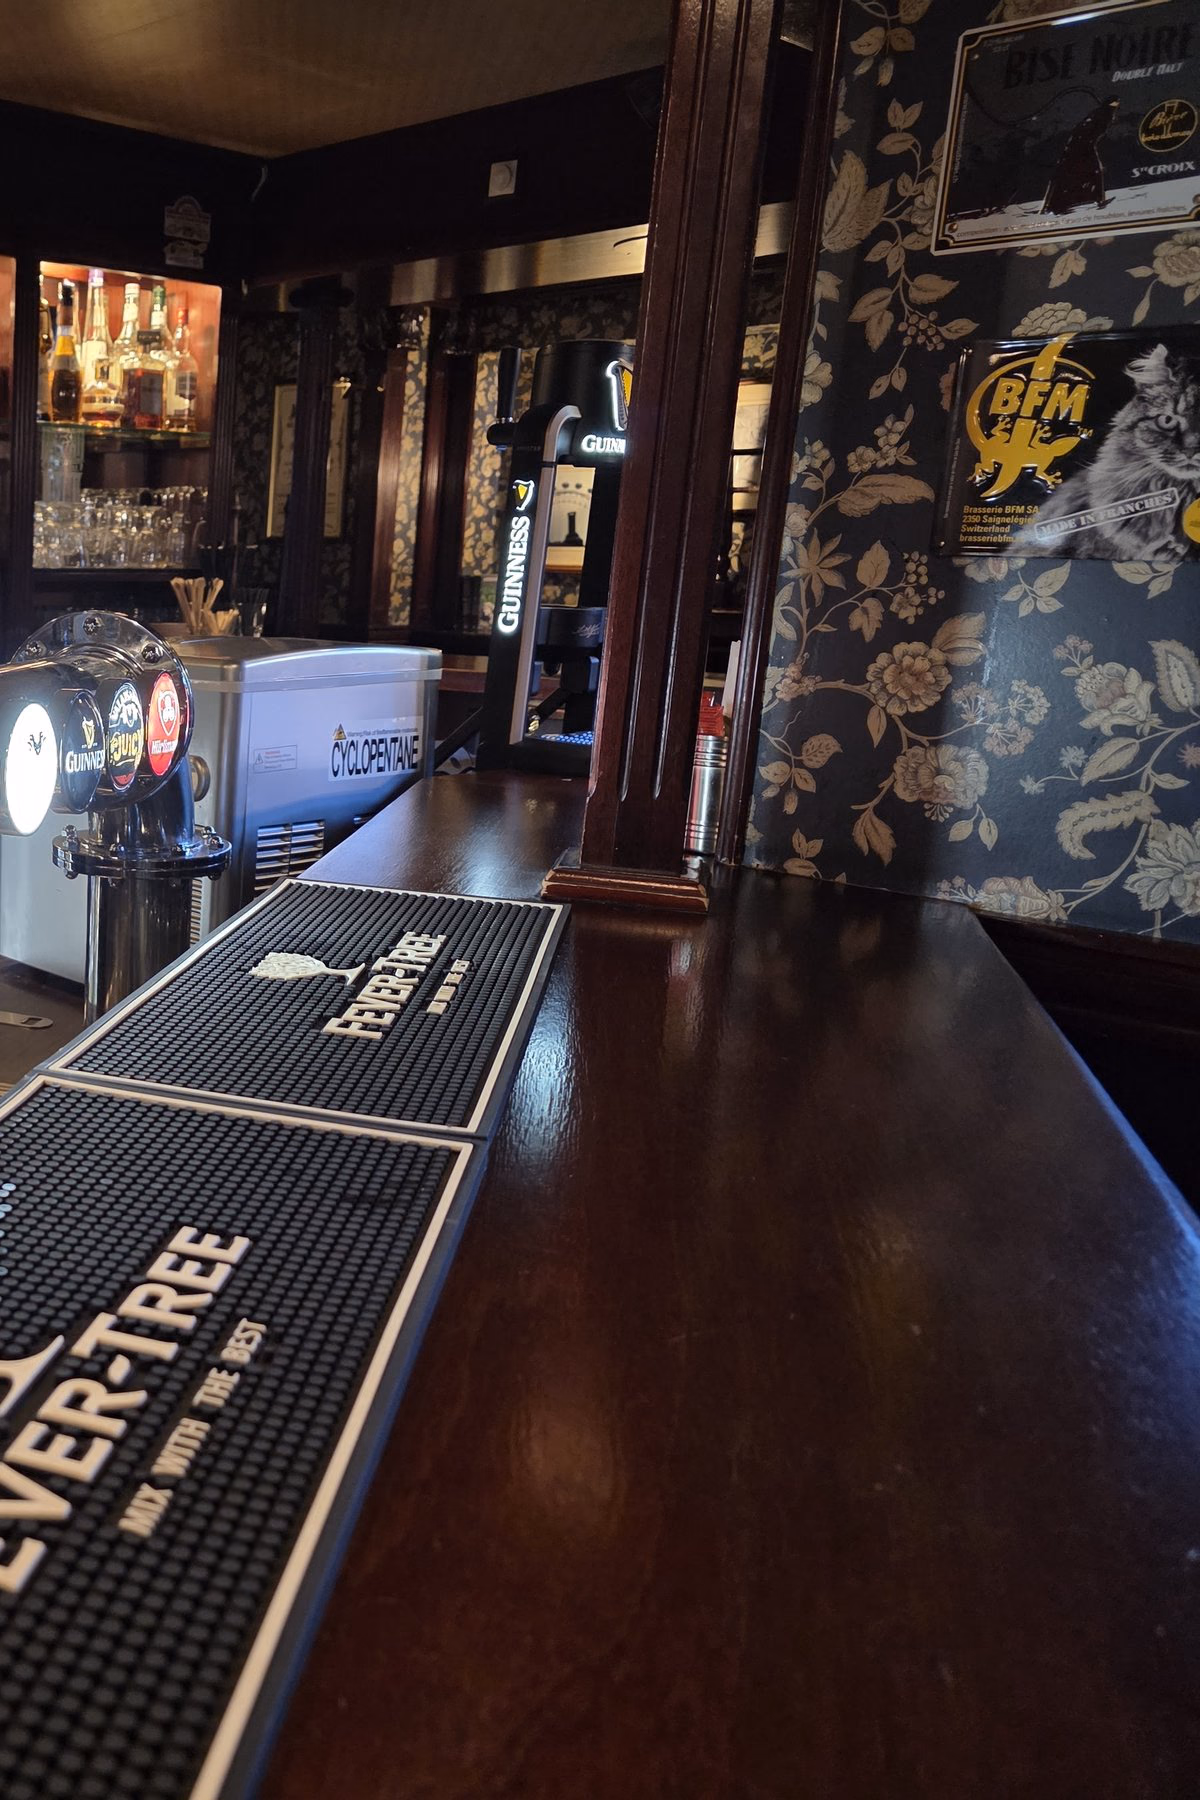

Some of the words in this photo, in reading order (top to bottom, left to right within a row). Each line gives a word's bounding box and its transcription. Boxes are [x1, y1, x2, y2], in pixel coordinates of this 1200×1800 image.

[988, 378, 1091, 423] BFM
[960, 525, 1010, 533] Switzerland
[962, 515, 981, 523] 2350
[963, 505, 1003, 514] Brasserie
[1004, 505, 1024, 514] BFM
[497, 514, 531, 635] GUINNESS
[331, 735, 419, 777] CYCLOPENTANE
[322, 931, 447, 1040] FEVER-TREE
[118, 1482, 175, 1537] MIX
[152, 1417, 211, 1477] WITH
[192, 1366, 241, 1407] THE
[221, 1317, 268, 1369] BEST
